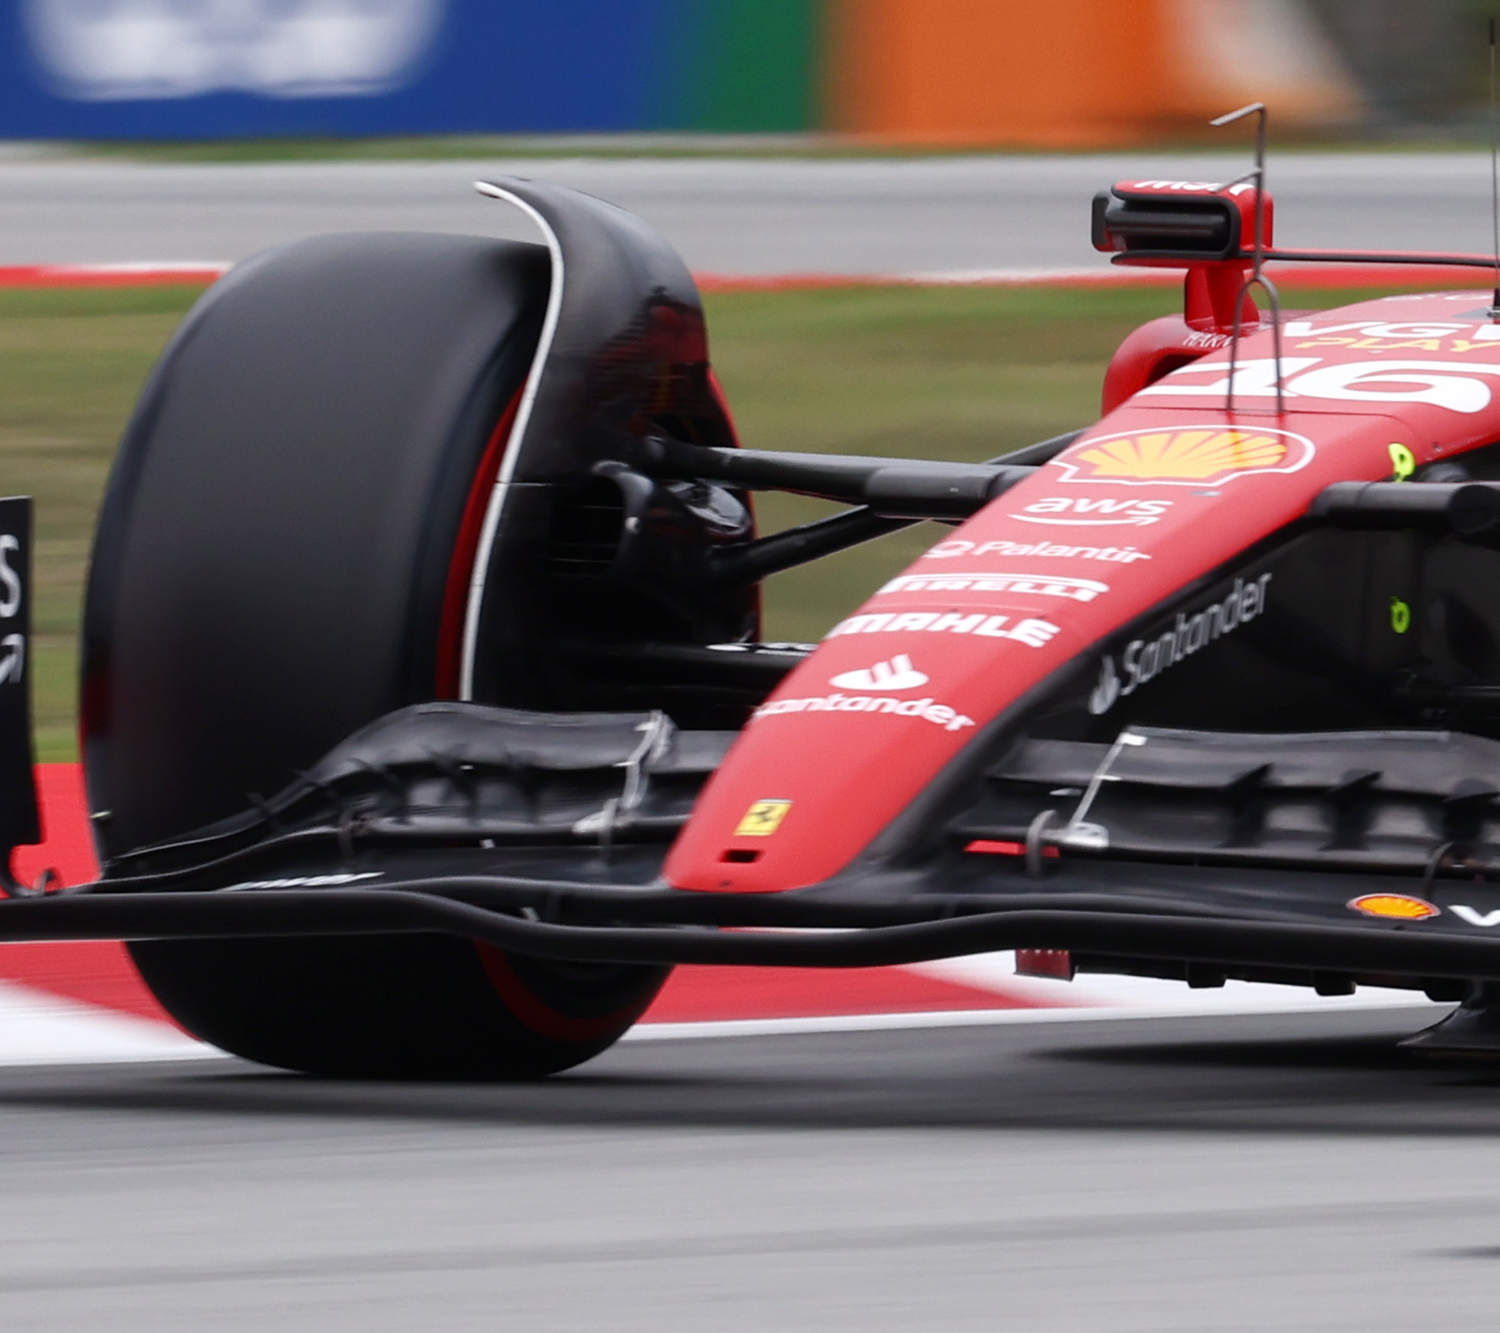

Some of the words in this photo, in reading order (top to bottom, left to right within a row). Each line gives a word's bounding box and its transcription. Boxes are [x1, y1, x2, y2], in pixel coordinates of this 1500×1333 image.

[1023, 497, 1174, 515] aws
[973, 541, 1152, 563] Palantir
[1120, 572, 1272, 696] Santander
